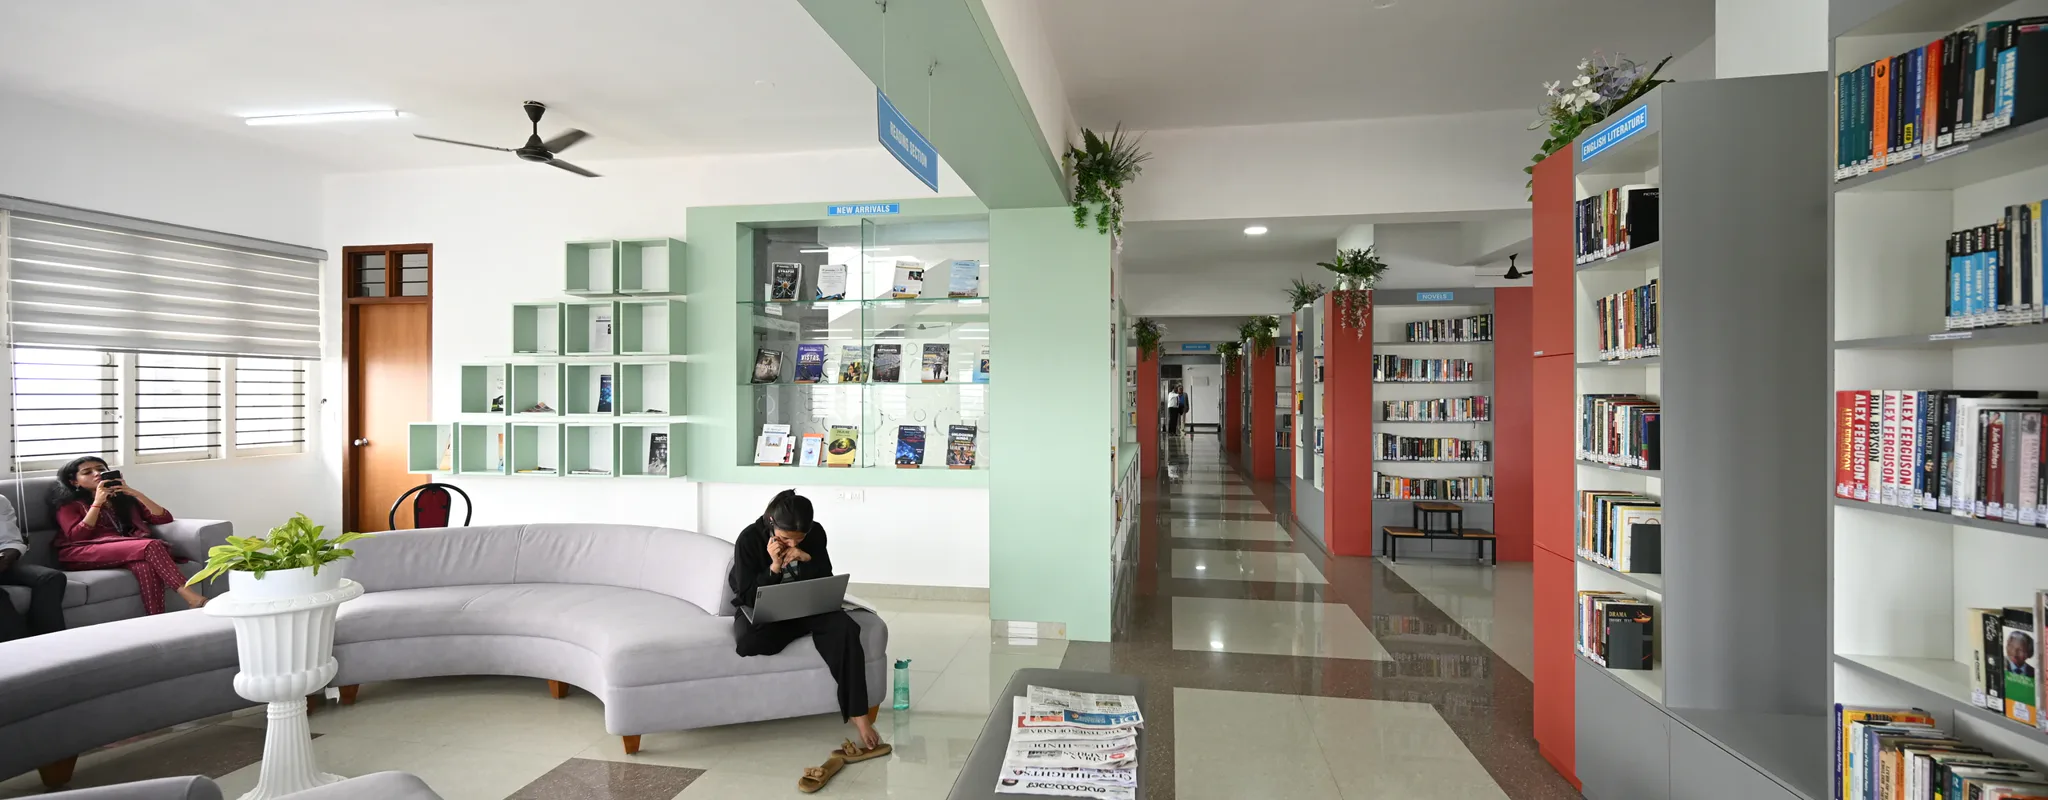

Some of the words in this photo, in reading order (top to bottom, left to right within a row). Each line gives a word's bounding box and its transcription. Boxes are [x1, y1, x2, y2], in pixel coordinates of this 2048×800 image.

[2004, 51, 2015, 96] HENRY
[890, 121, 909, 152] READING
[909, 142, 927, 168] SECTION
[1584, 135, 1606, 155] ENGLISH
[1607, 112, 1644, 142] LITERATURE
[836, 206, 853, 214] NEW
[855, 205, 890, 213] ARRIVALS
[1842, 408, 1852, 427] ALEX
[1855, 394, 1866, 420] ALEX
[1870, 395, 1879, 417] BILL
[1883, 395, 1895, 421] ALEX
[1902, 394, 1913, 421] ALEX
[1869, 422, 1879, 462] BRYSON
[1925, 426, 1933, 455] BARKER
[1992, 427, 2000, 442] Julie
[1840, 429, 1852, 471] FERGUSON
[1854, 424, 1866, 480] FERGUSON
[1883, 427, 1895, 484] FERGUSON
[1900, 427, 1912, 485] FERGUSON
[1991, 443, 1999, 469] Walters
